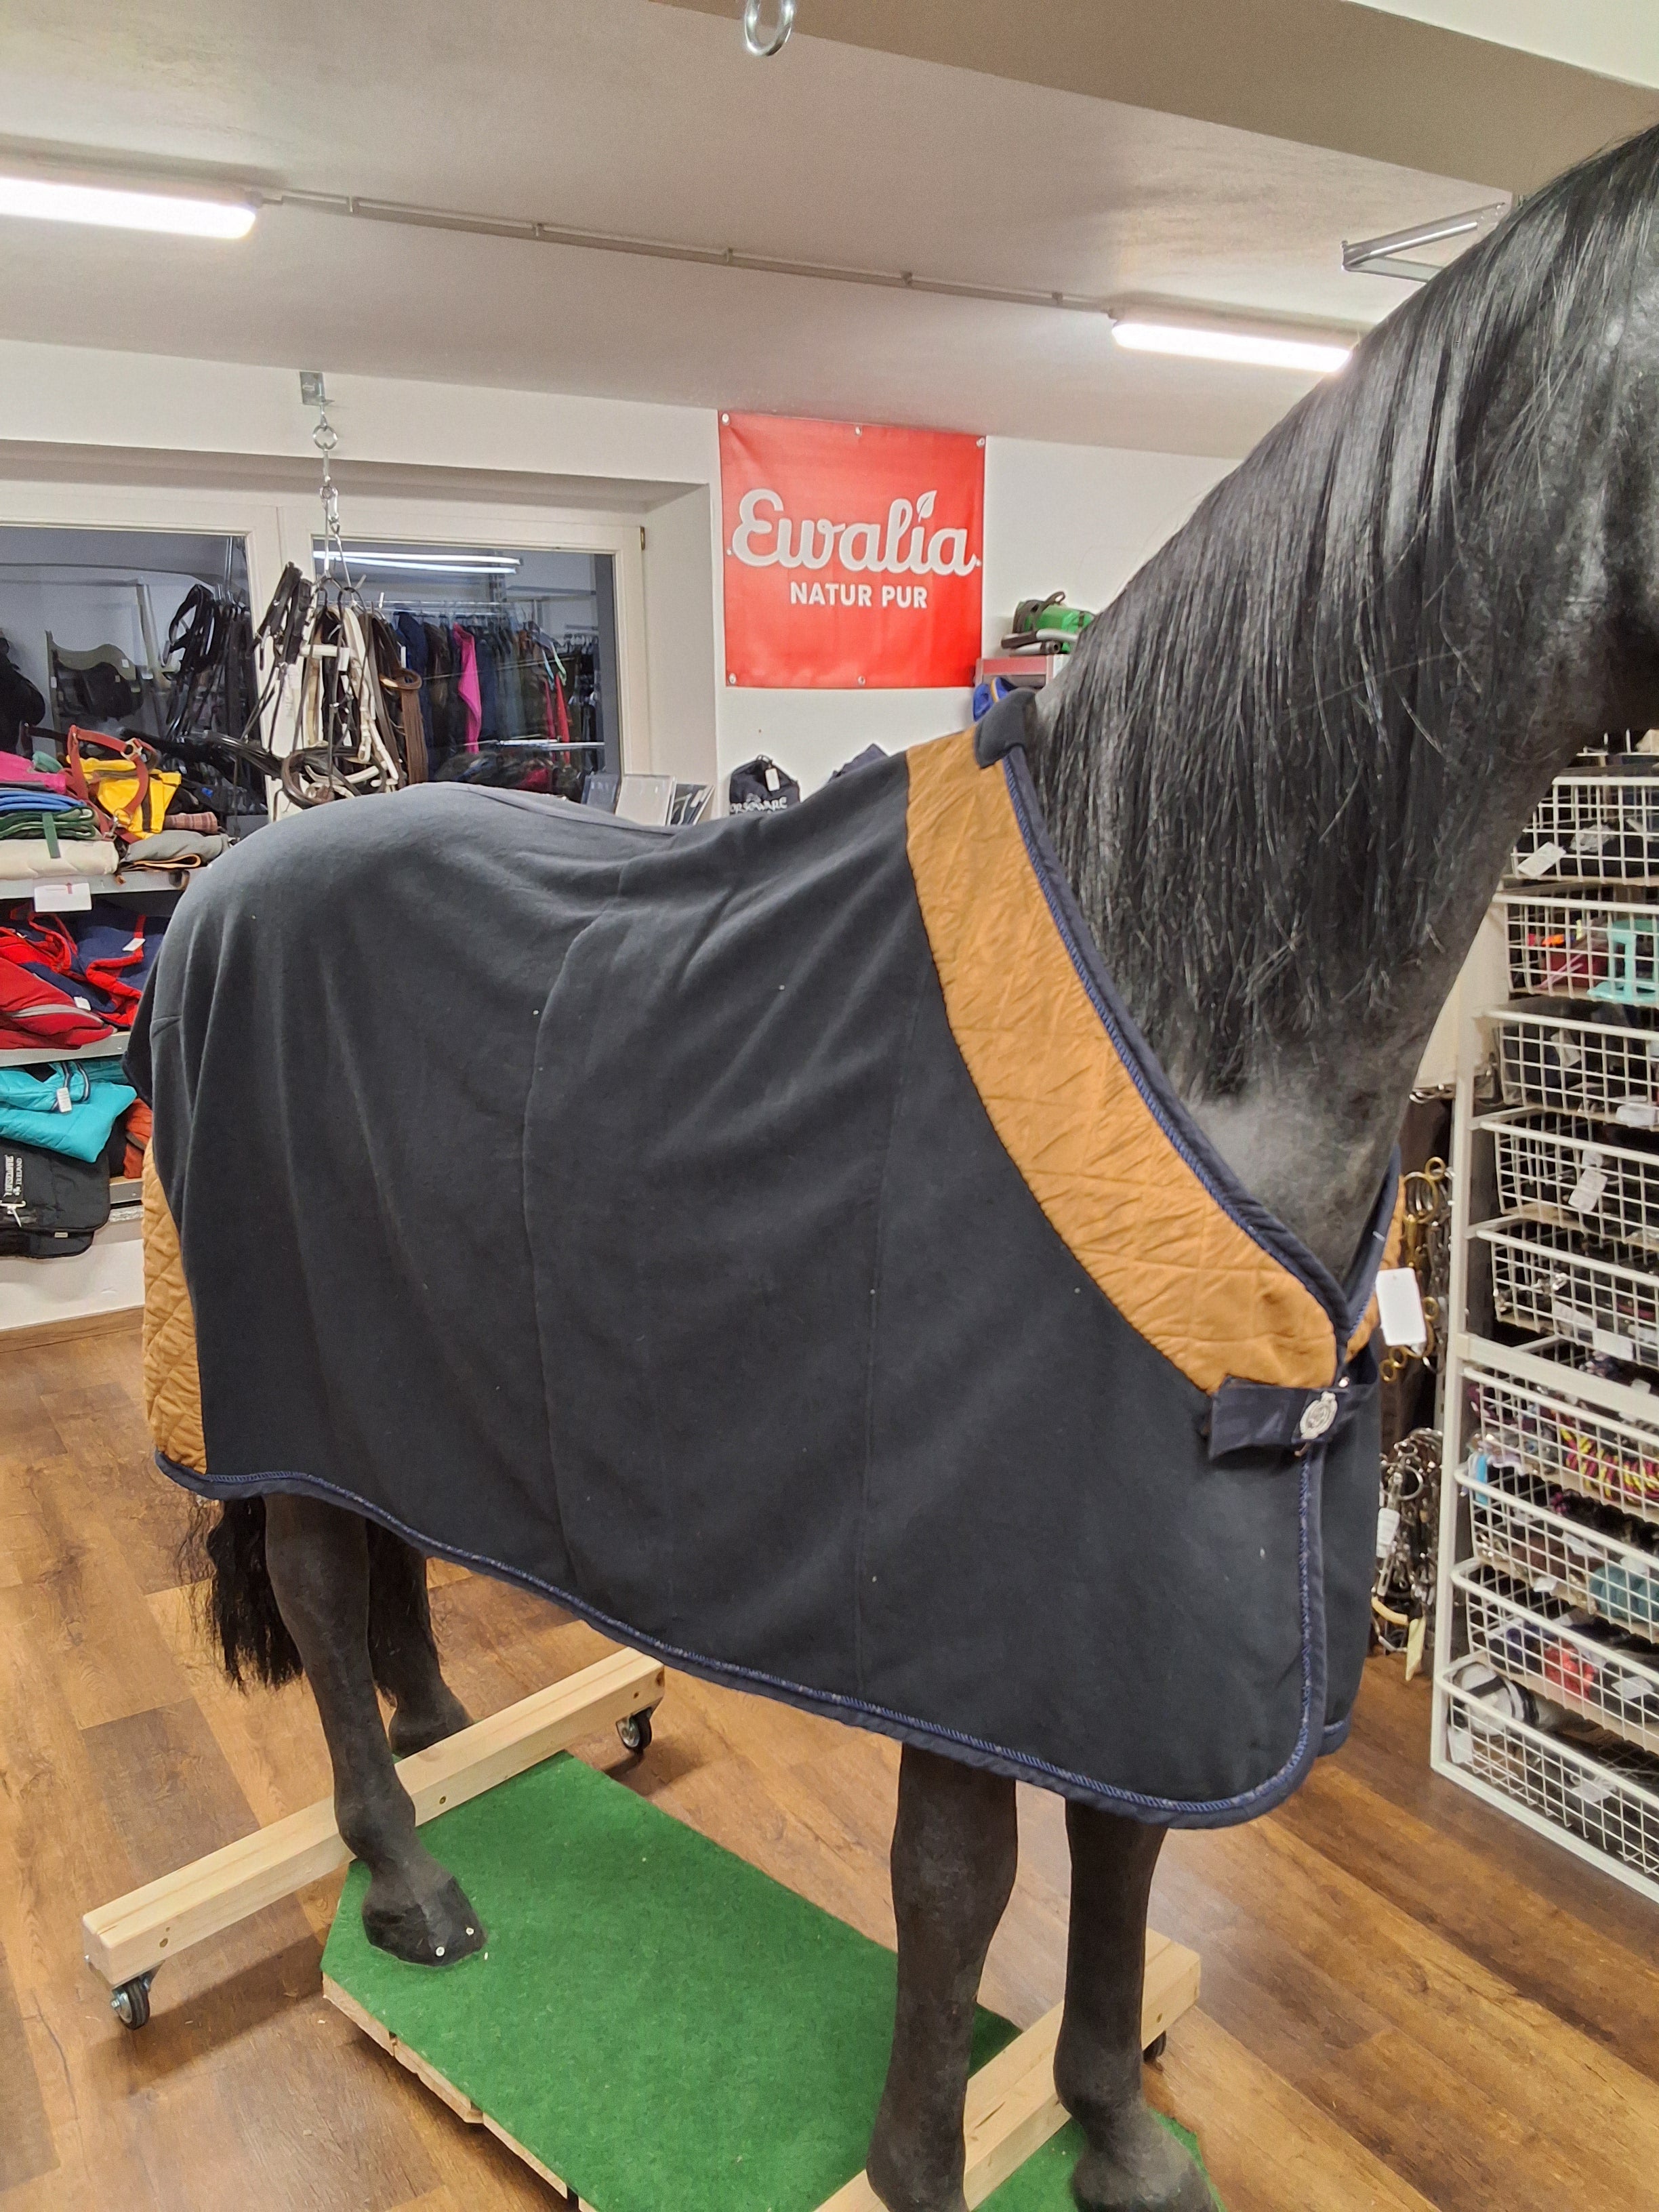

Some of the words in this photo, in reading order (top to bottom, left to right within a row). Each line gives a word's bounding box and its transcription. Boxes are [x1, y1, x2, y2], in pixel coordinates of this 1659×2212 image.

[732, 489, 978, 576] Ewalia
[790, 581, 872, 607] NATUR
[882, 585, 928, 609] PUR
